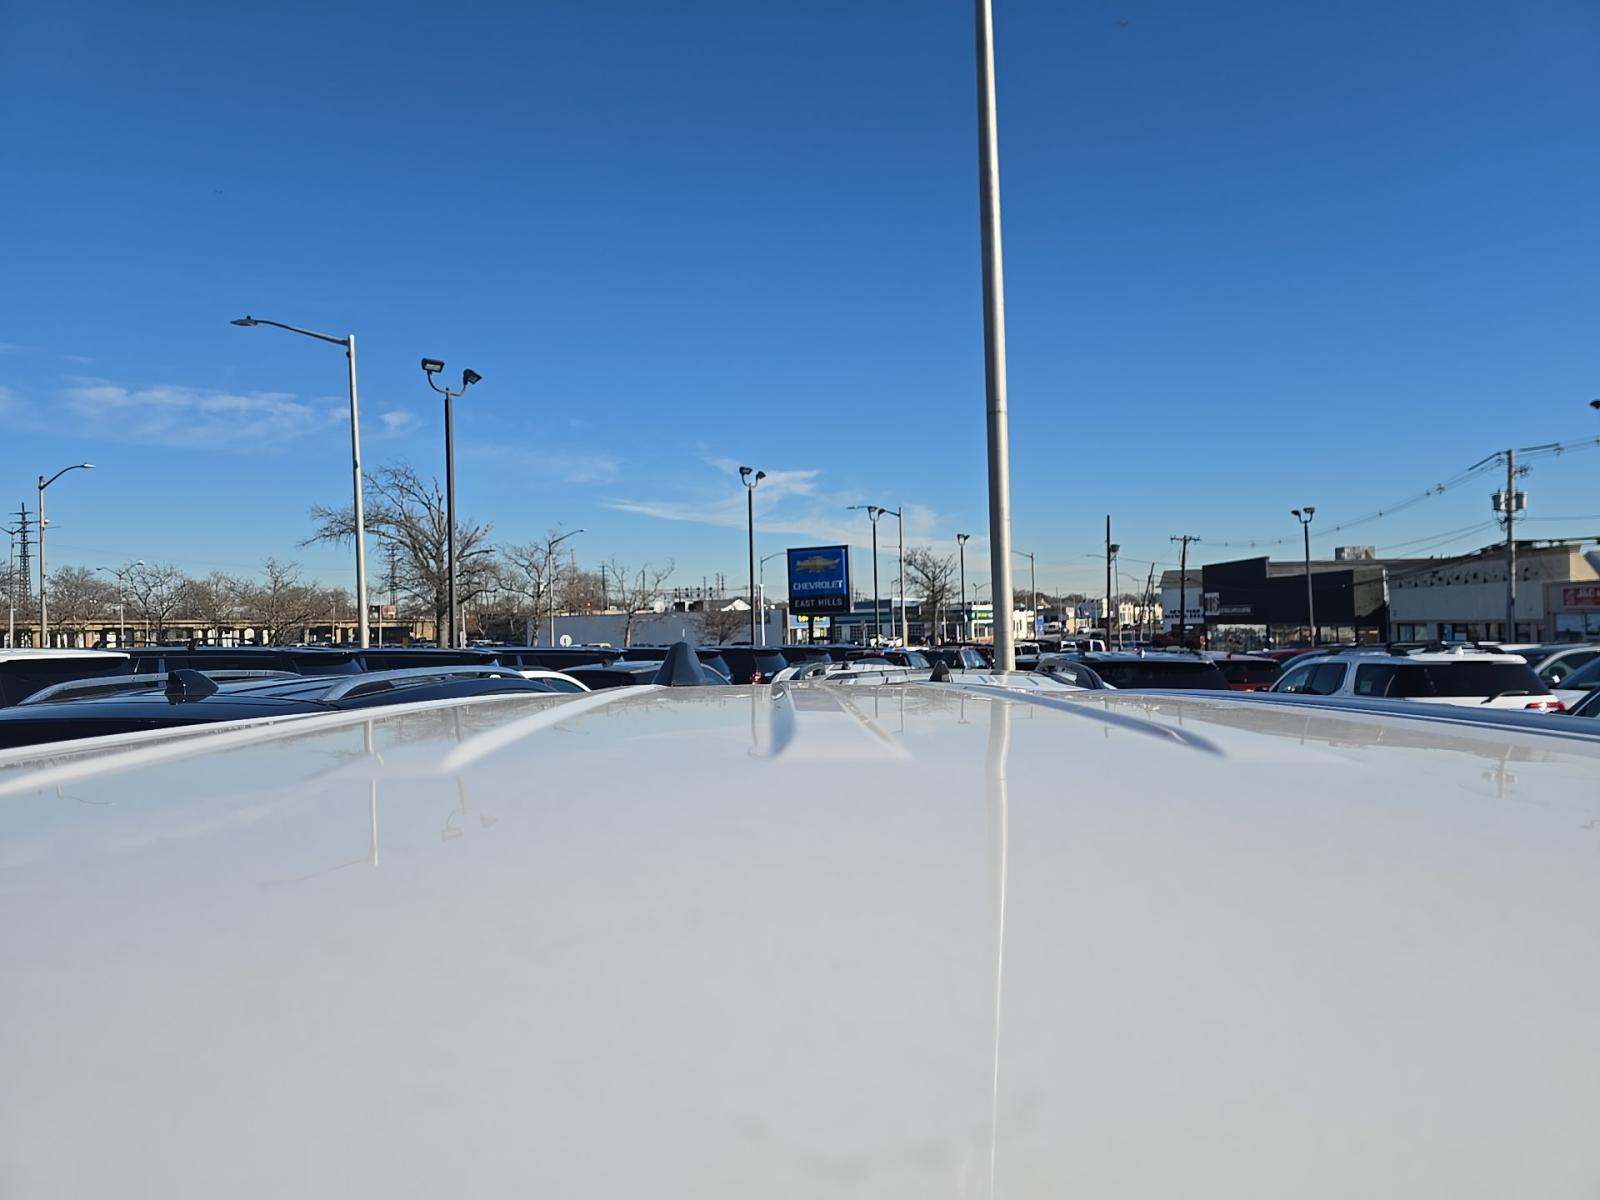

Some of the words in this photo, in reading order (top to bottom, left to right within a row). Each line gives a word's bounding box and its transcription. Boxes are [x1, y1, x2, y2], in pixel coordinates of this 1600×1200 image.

[793, 580, 843, 590] CHEVROLET
[794, 600, 815, 608] EAST
[818, 598, 842, 607] HILLS
